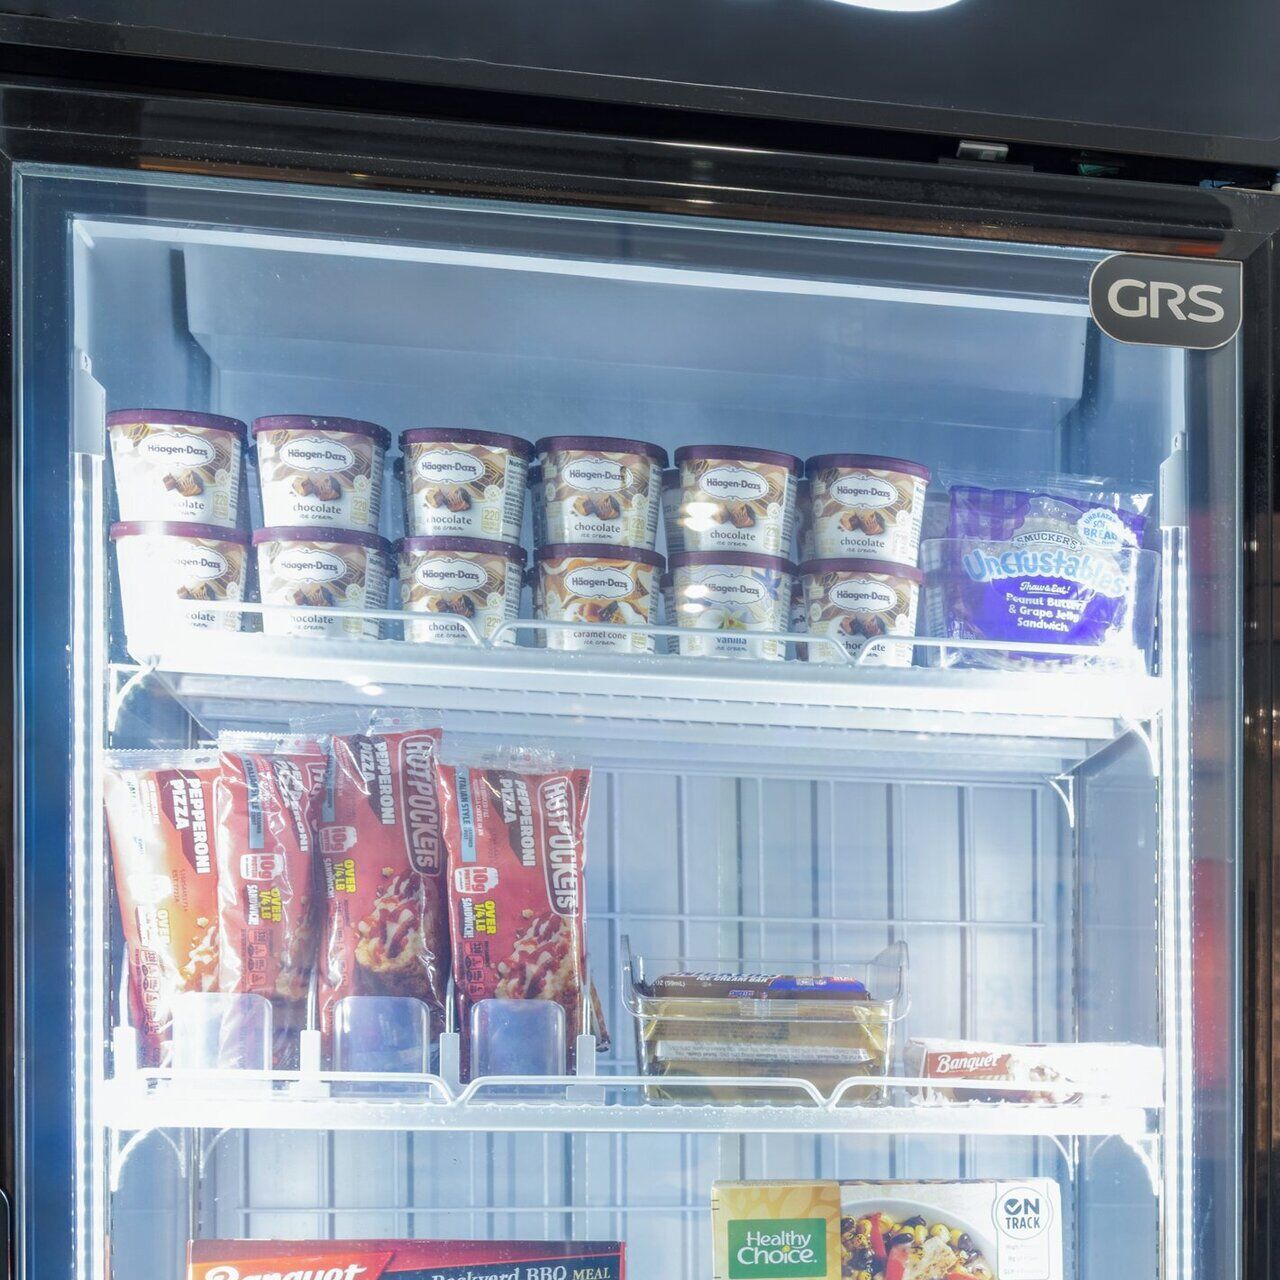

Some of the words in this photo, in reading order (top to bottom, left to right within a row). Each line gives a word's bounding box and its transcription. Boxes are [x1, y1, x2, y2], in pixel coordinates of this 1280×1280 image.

[1107, 278, 1224, 323] GRS
[288, 449, 347, 463] Häagen-Dazs
[421, 461, 477, 475] Häagen-Dazs
[706, 477, 761, 492] Häagen-Dazs
[836, 486, 891, 500] Häagen-Dazs
[422, 569, 480, 583] Häagen-Dazs
[572, 577, 628, 590] Häagen-Dazs
[837, 590, 891, 604] Häagen-Dazs
[1008, 604, 1016, 614] &
[1019, 607, 1053, 620] Grape
[1056, 611, 1080, 624] Jelly
[1017, 617, 1069, 632] Sandwich
[359, 742, 375, 783] PIZZA
[374, 742, 395, 825] PEPPERONI
[170, 778, 190, 831] PIZZA
[499, 778, 517, 824] PIZZA
[515, 780, 536, 867] PEPPERONI
[935, 1053, 1000, 1075] Banquet
[1005, 1217, 1041, 1230] TRACK
[746, 1229, 812, 1251] Healthy
[573, 1267, 610, 1280] MEAL
